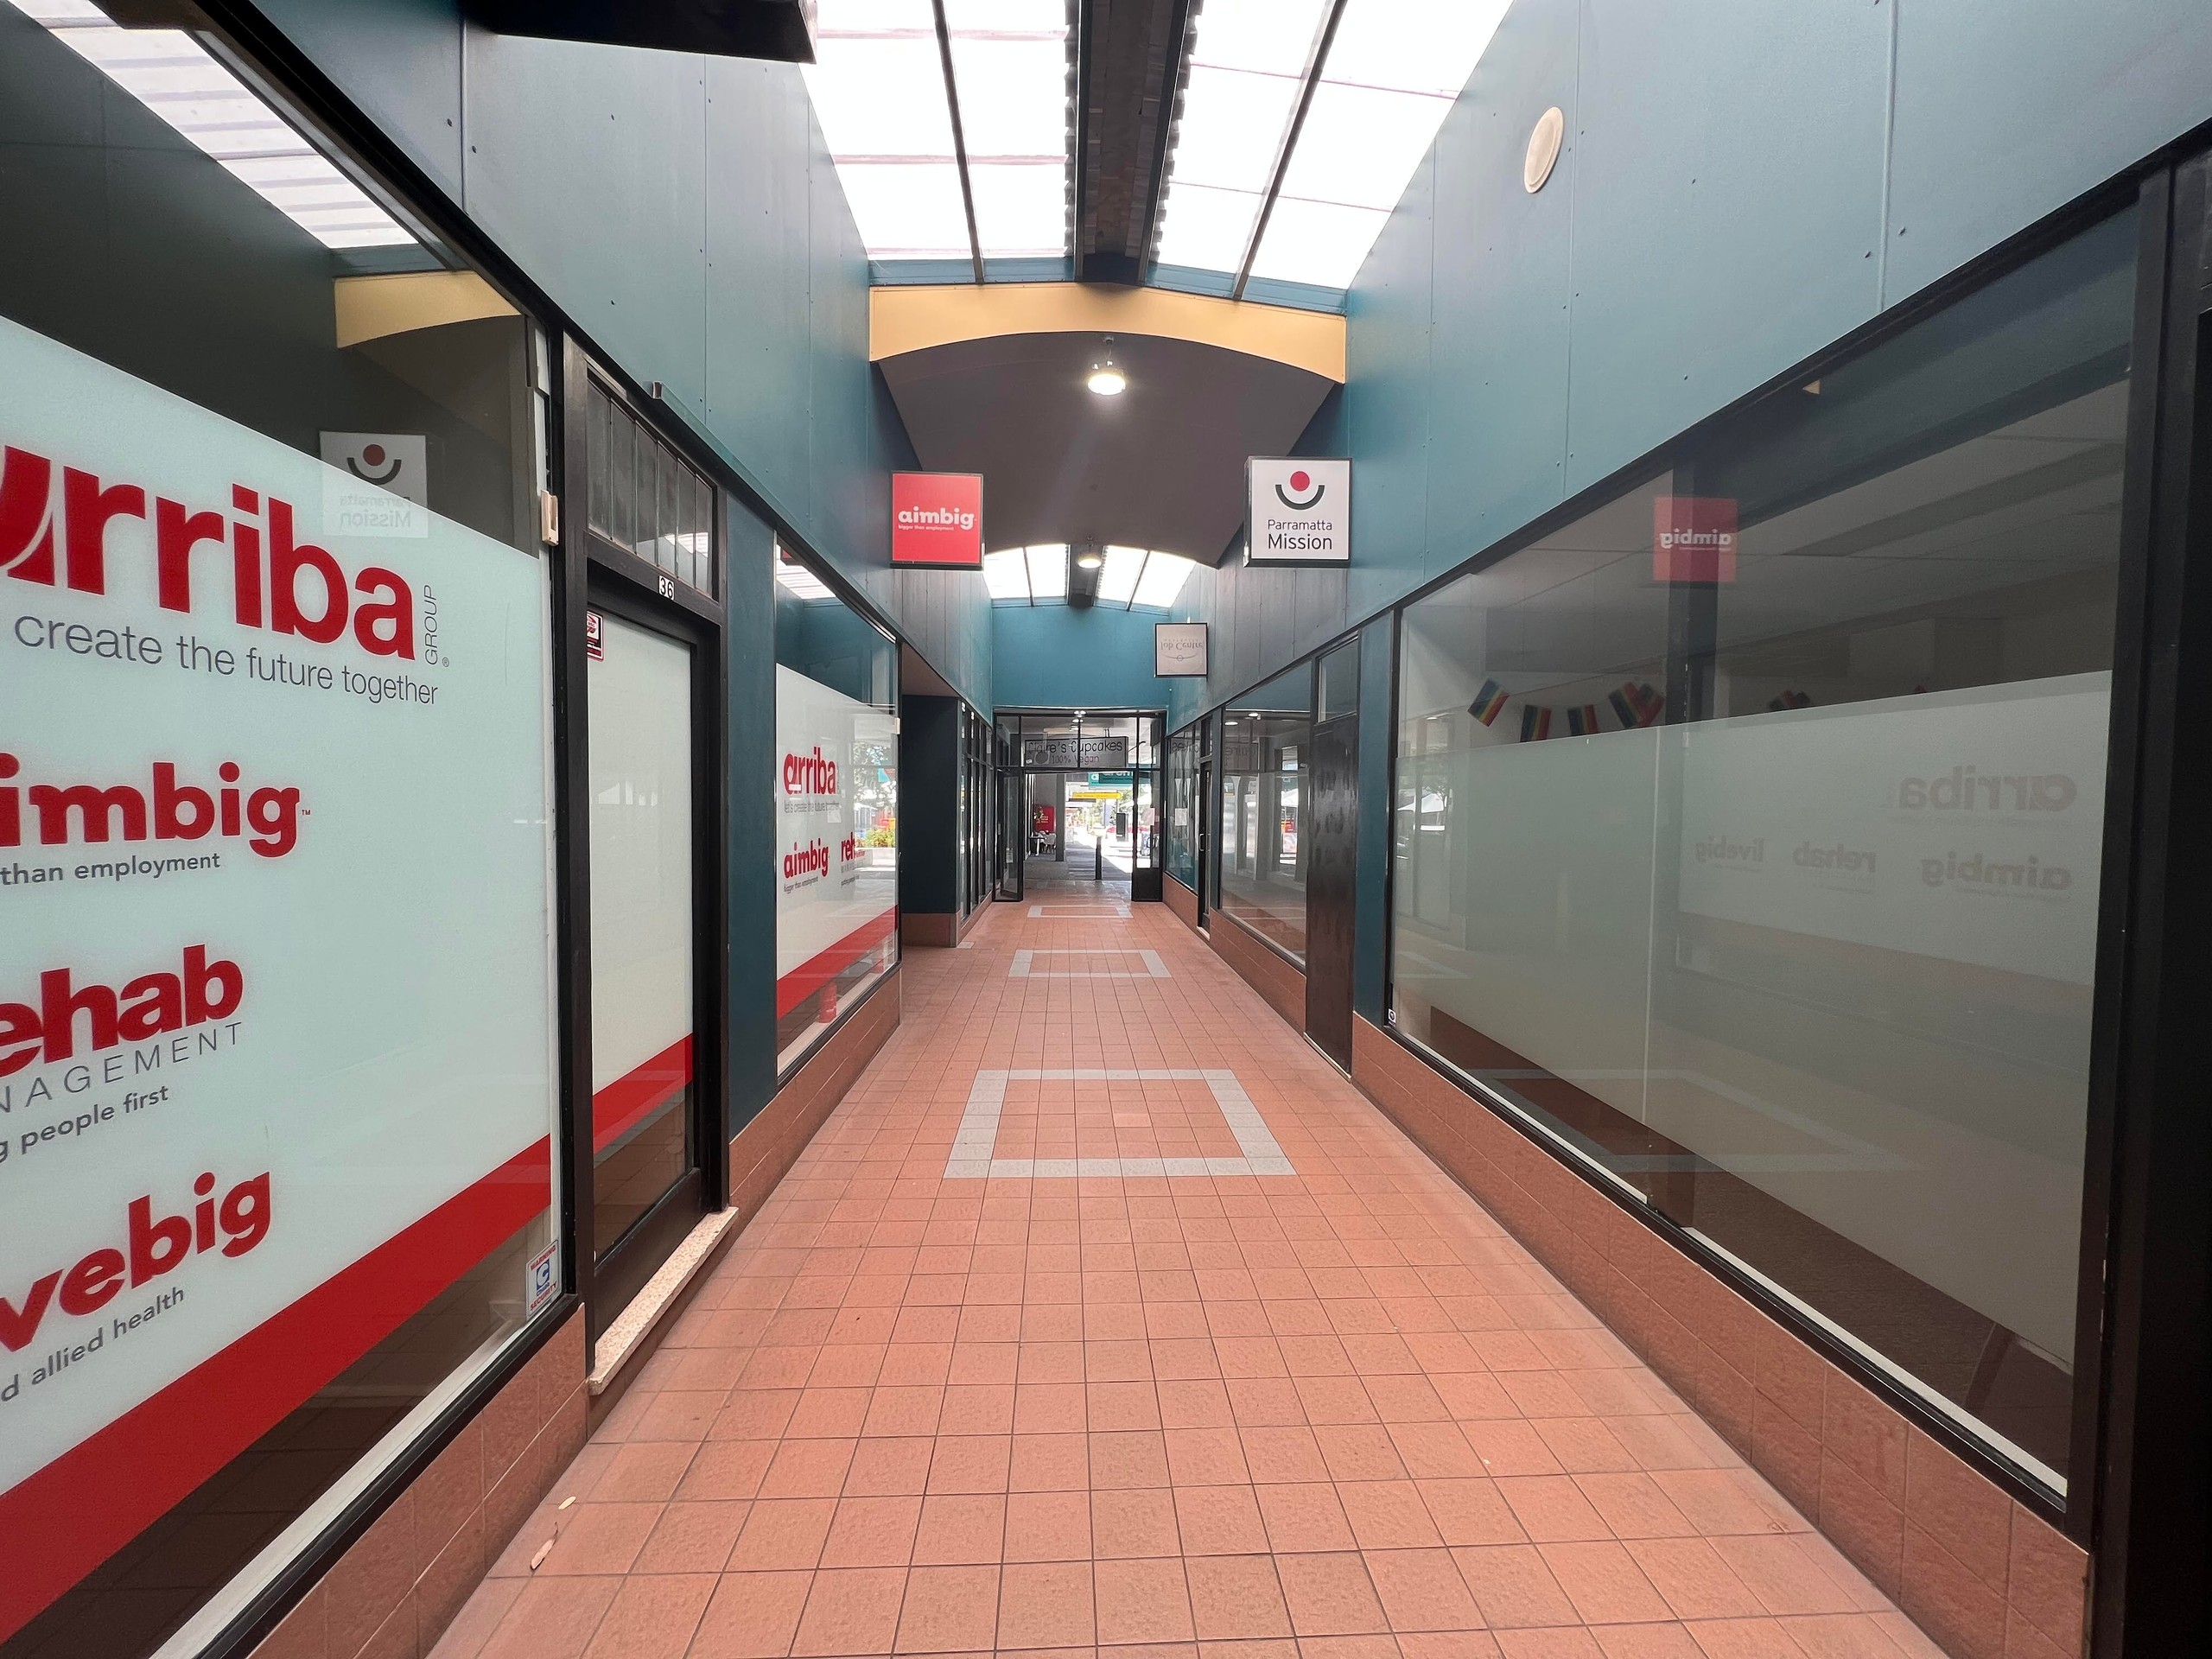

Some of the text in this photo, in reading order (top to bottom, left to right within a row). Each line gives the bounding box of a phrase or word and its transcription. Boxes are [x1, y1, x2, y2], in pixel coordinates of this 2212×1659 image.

[898, 505, 975, 531] aimbig
[1268, 519, 1332, 531] Parramatta
[1268, 533, 1332, 550] Mission
[659, 577, 674, 600] 36
[423, 585, 438, 665] GROUP
[15, 615, 438, 705] create the future together
[1052, 754, 1071, 764] 100%
[1071, 741, 1122, 755] Cupcakes
[784, 746, 836, 795] arriba
[1, 852, 221, 886] than employment
[784, 837, 829, 879] aimbig
[21, 1104, 115, 1155] people
[123, 1085, 169, 1114] first
[530, 1281, 557, 1312] SECURITY
[31, 1326, 104, 1385] allied
[113, 1287, 184, 1340] health
